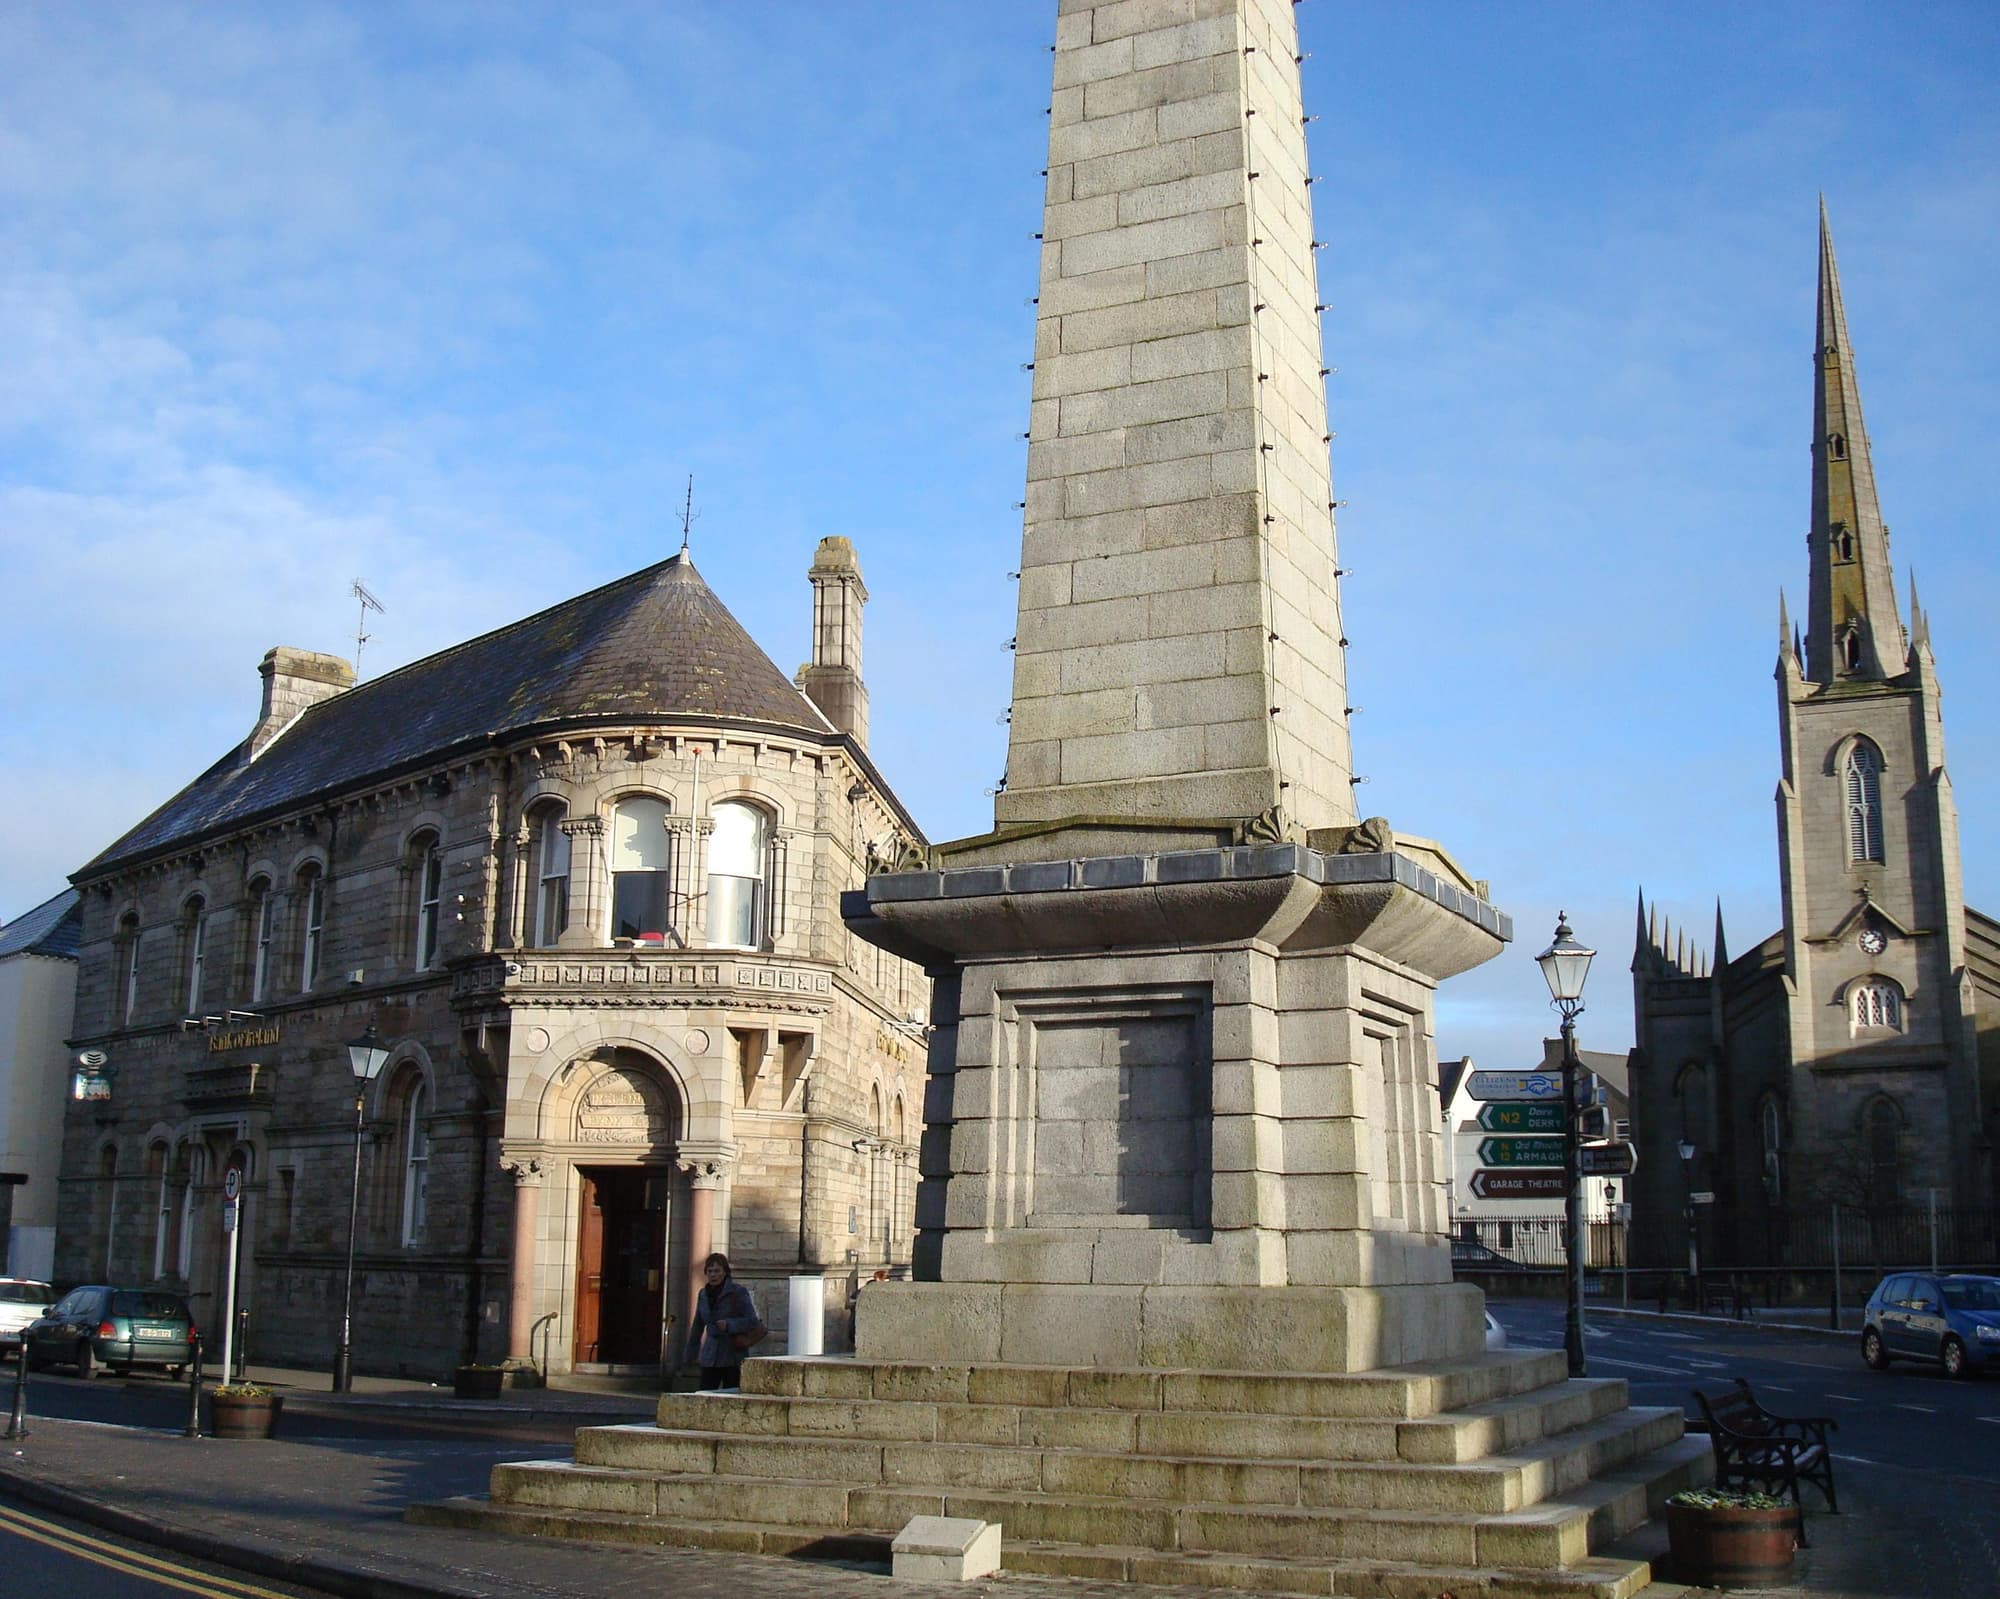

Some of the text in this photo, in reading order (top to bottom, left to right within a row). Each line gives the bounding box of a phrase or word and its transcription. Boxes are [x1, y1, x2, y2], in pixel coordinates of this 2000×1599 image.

[1500, 1111, 1520, 1124] N2
[1528, 1119, 1561, 1128] DERRY
[1515, 1152, 1564, 1161] ARMAGH
[1490, 1180, 1563, 1189] GARAGE THEATRE
